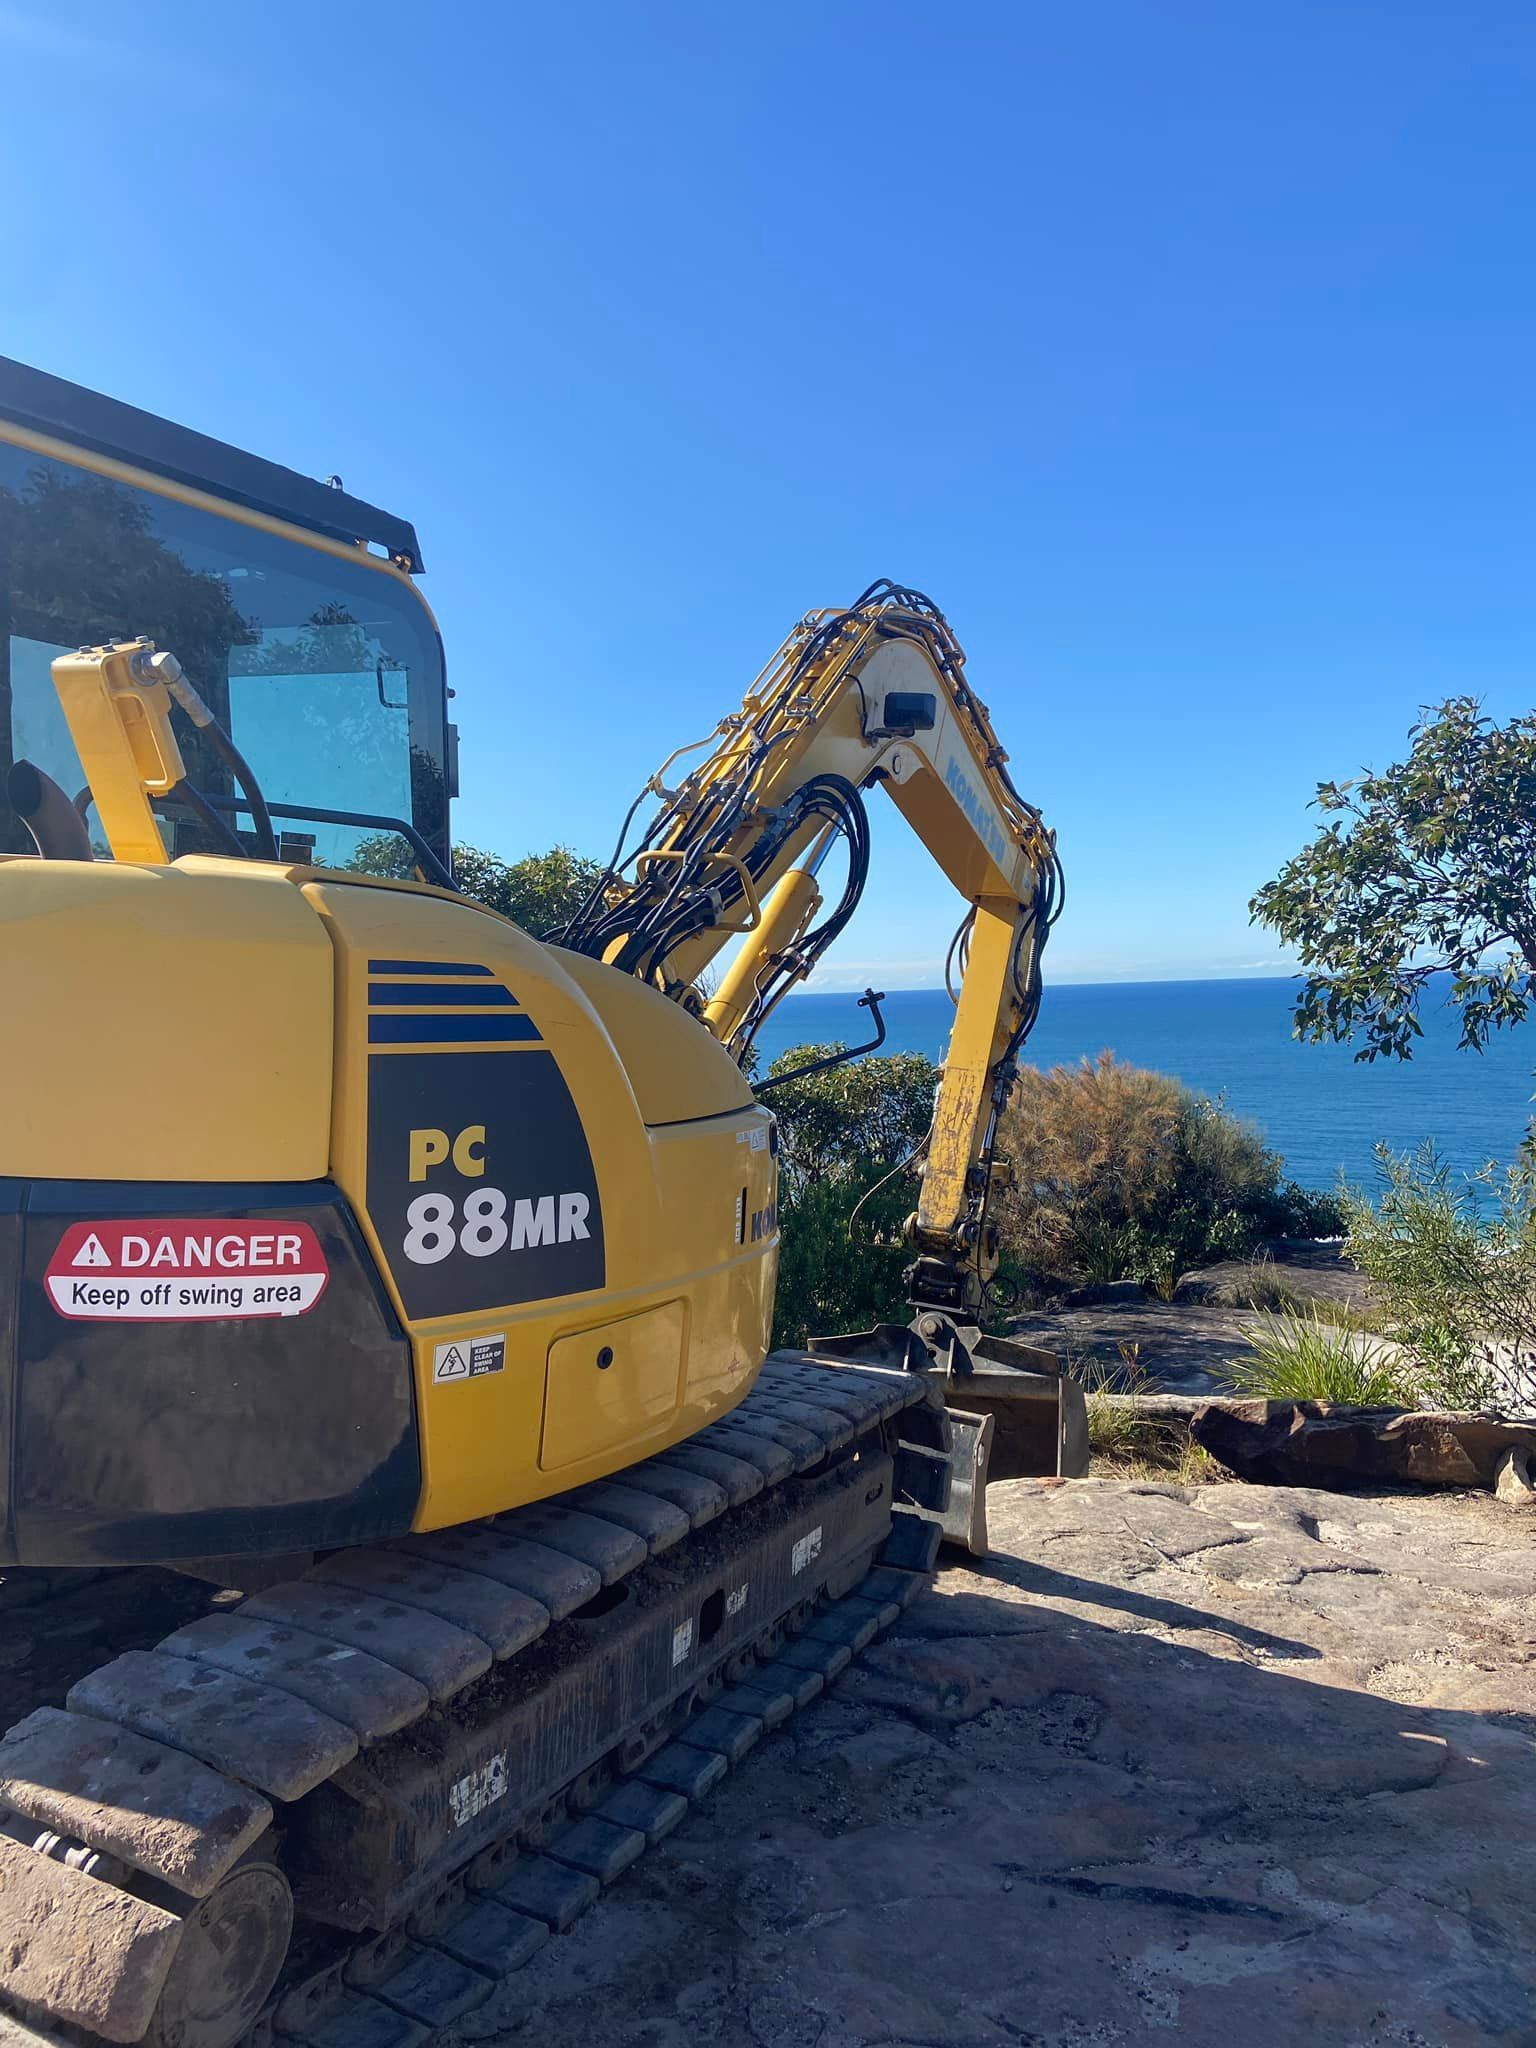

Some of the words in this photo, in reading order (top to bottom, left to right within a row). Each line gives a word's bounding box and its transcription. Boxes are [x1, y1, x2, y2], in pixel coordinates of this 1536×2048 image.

[945, 755, 1006, 863] KOMATSU
[409, 1125, 486, 1182] PC
[403, 1187, 591, 1265] 88MR
[121, 1235, 302, 1268] DANGER
[72, 1282, 130, 1309] Keep
[140, 1284, 172, 1305] off
[178, 1284, 243, 1308] swing
[253, 1285, 302, 1303] area
[473, 1359, 493, 1367] SWING
[474, 1346, 490, 1354] KEEP
[474, 1352, 493, 1361] CLEAR
[473, 1366, 489, 1374] AREA
